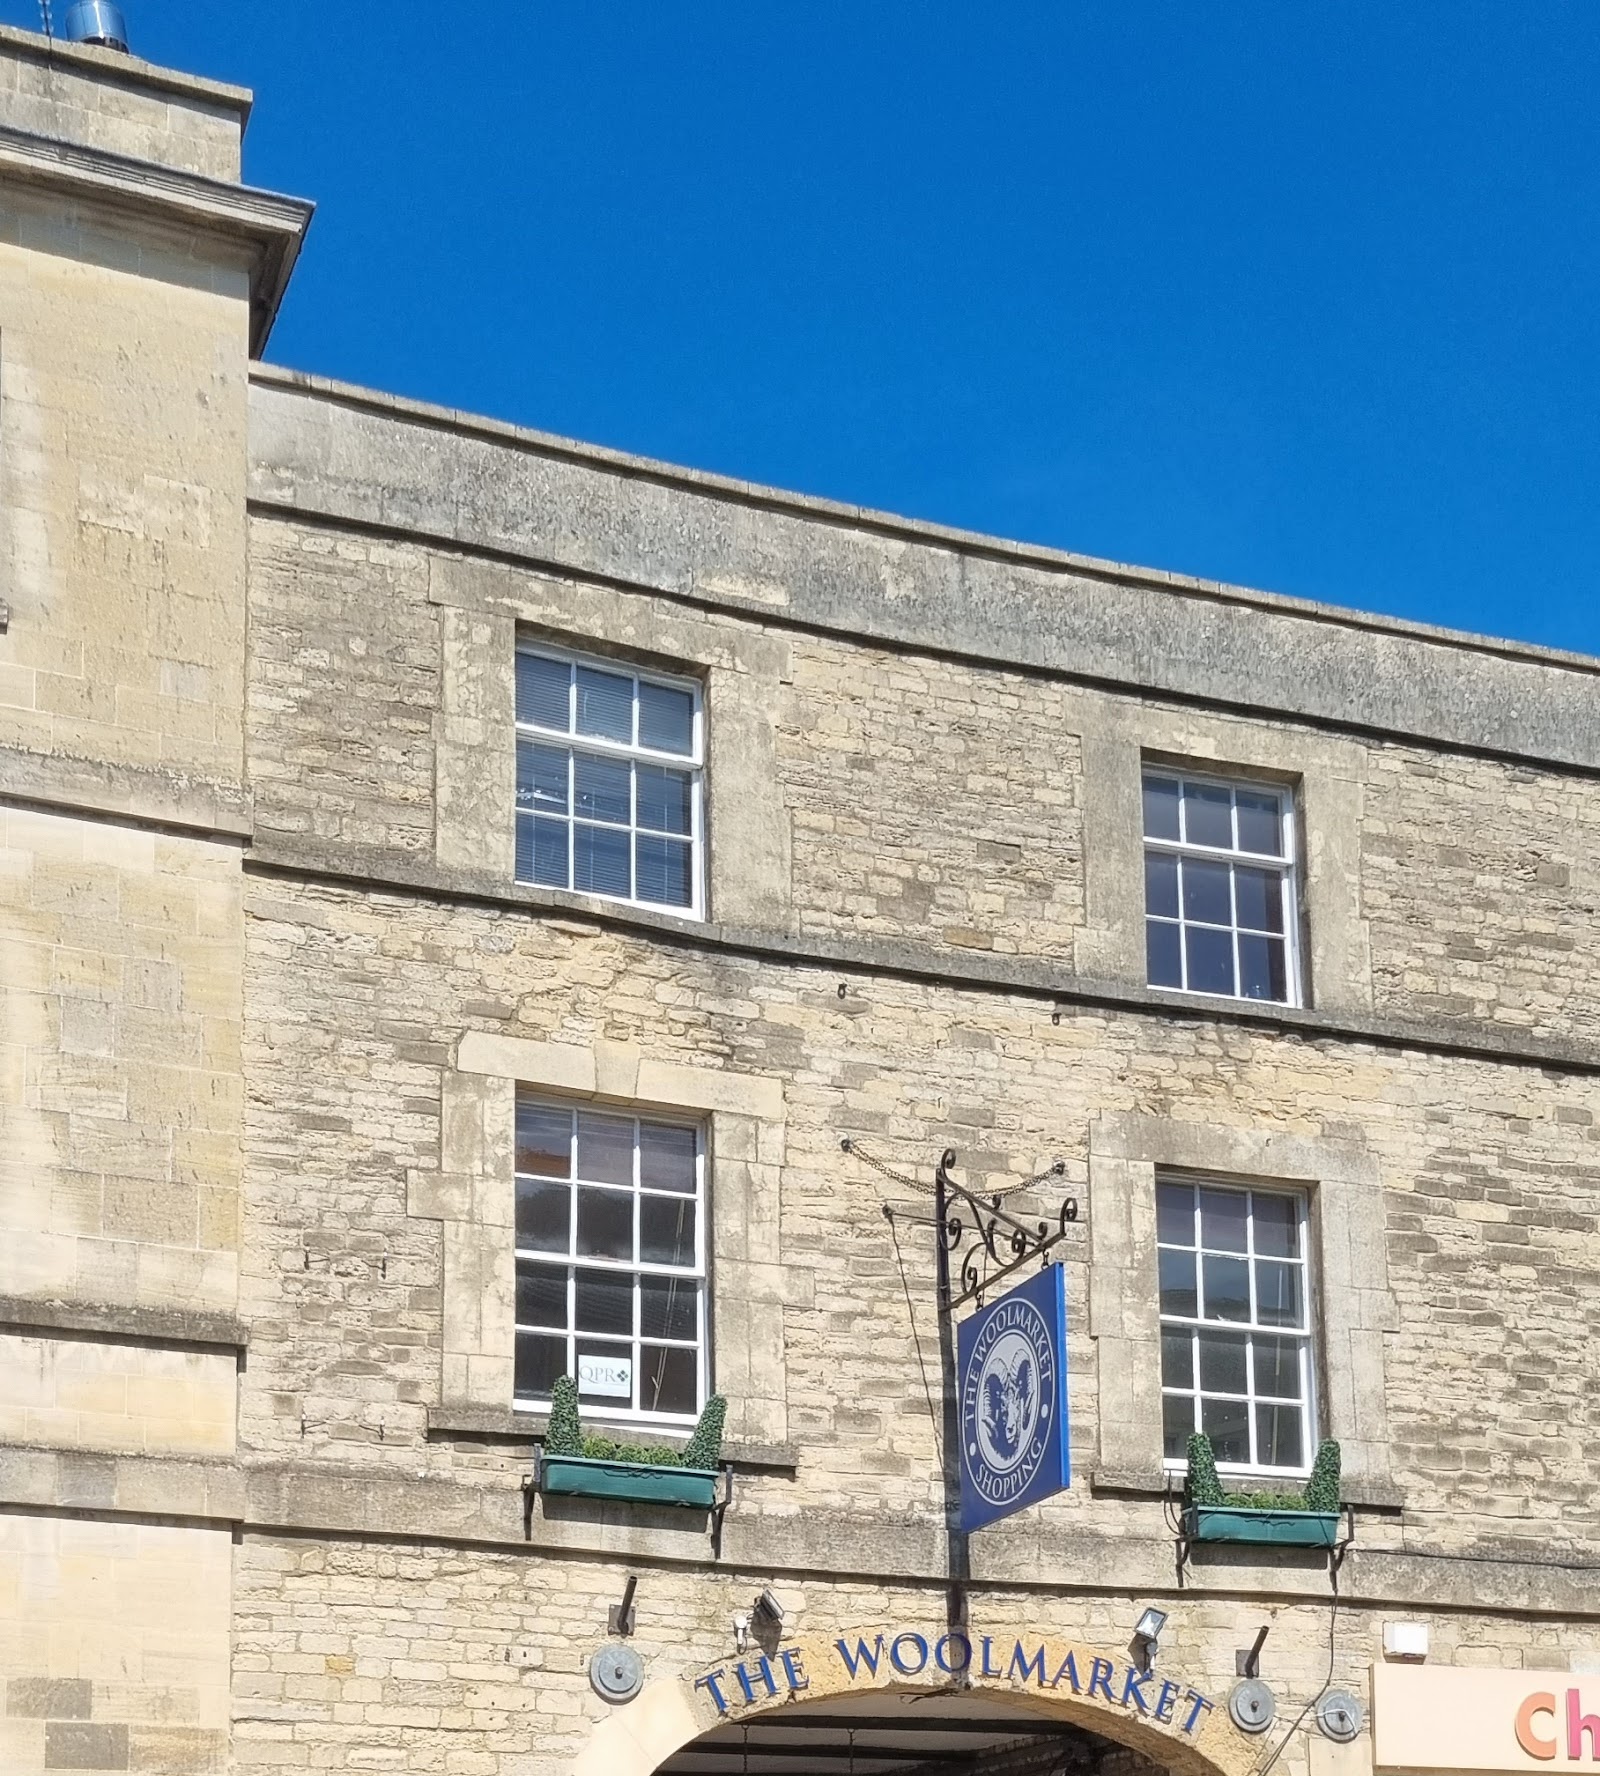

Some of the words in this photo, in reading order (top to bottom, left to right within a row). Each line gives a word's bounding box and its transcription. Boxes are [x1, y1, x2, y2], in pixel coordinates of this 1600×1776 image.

[579, 1365, 616, 1384] QPR
[965, 1368, 980, 1427] THE
[975, 1304, 1051, 1381] WOOLMARKET
[976, 1437, 1042, 1498] SHOPPING
[694, 1647, 810, 1713] THE
[833, 1632, 1215, 1734] WOOLMARKET
